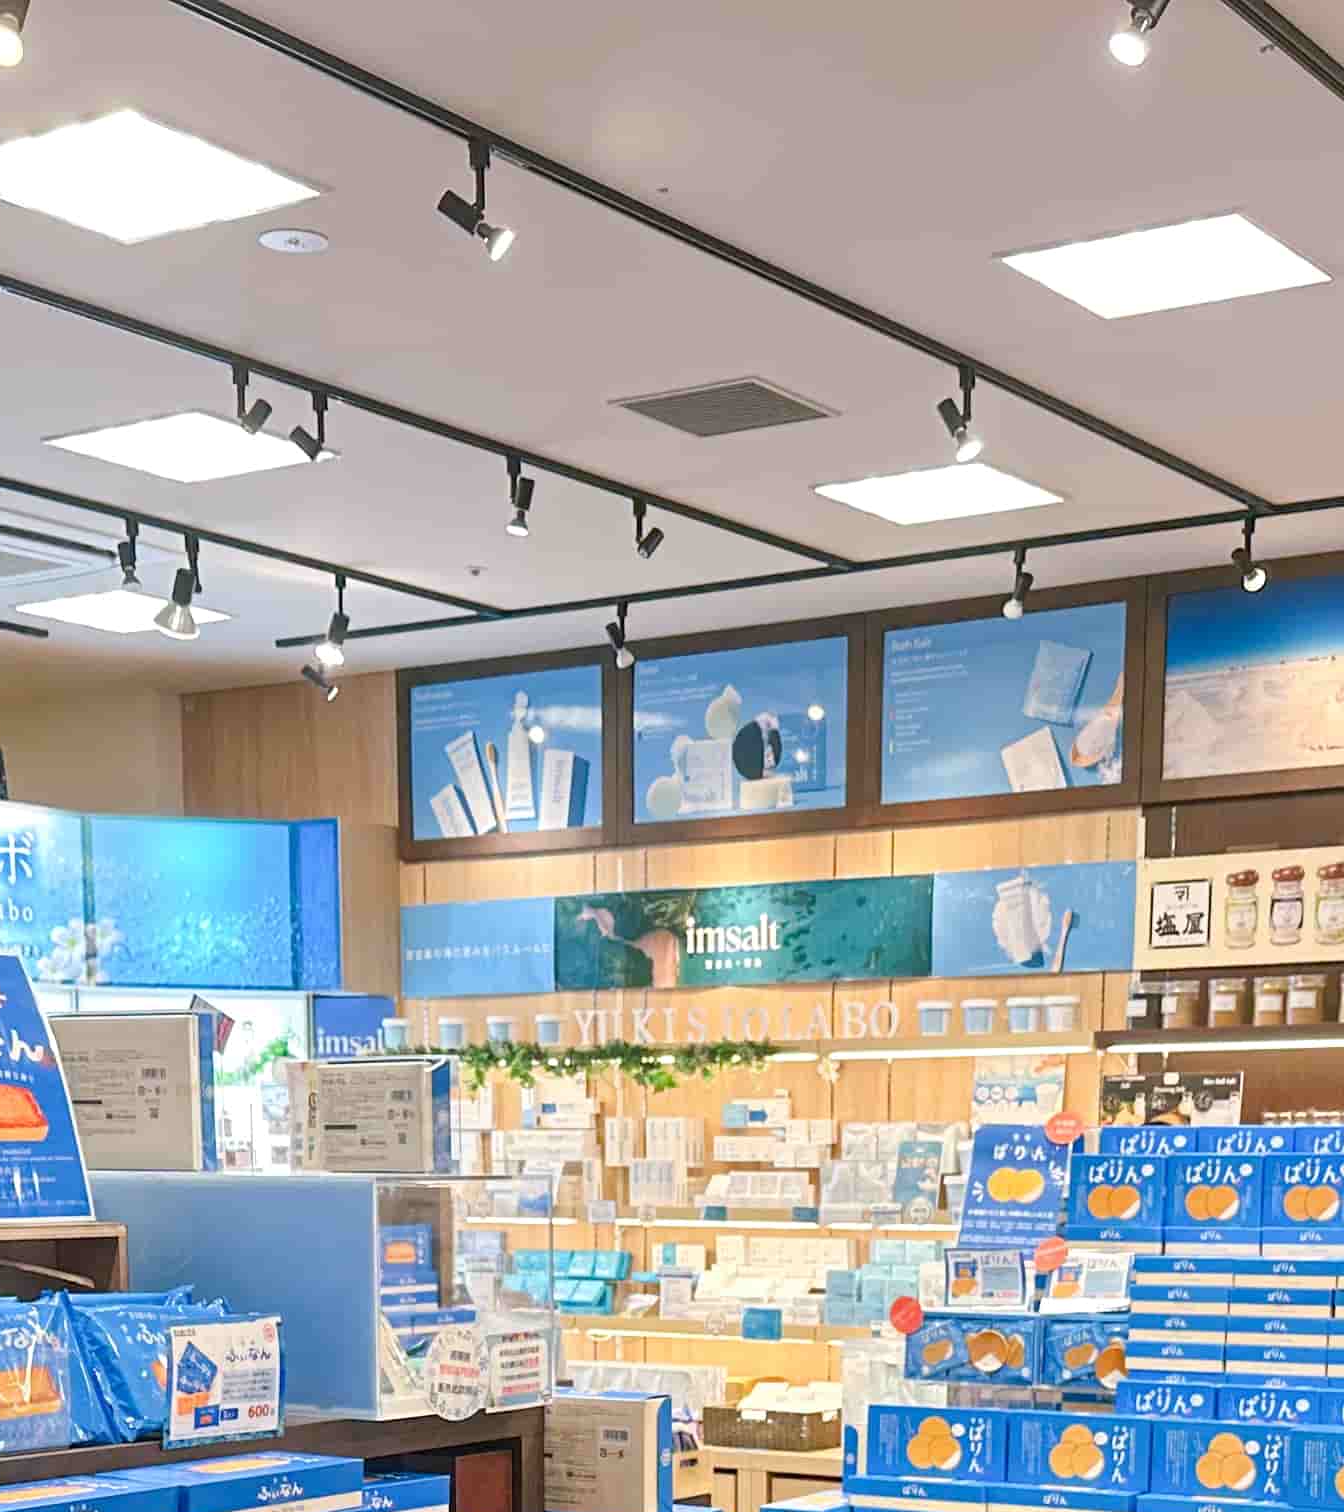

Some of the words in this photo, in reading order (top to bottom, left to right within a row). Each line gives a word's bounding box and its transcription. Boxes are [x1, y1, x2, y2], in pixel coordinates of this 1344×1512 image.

[686, 912, 781, 954] imsalt
[317, 1024, 383, 1056] imsal
[248, 1403, 270, 1418] 600
